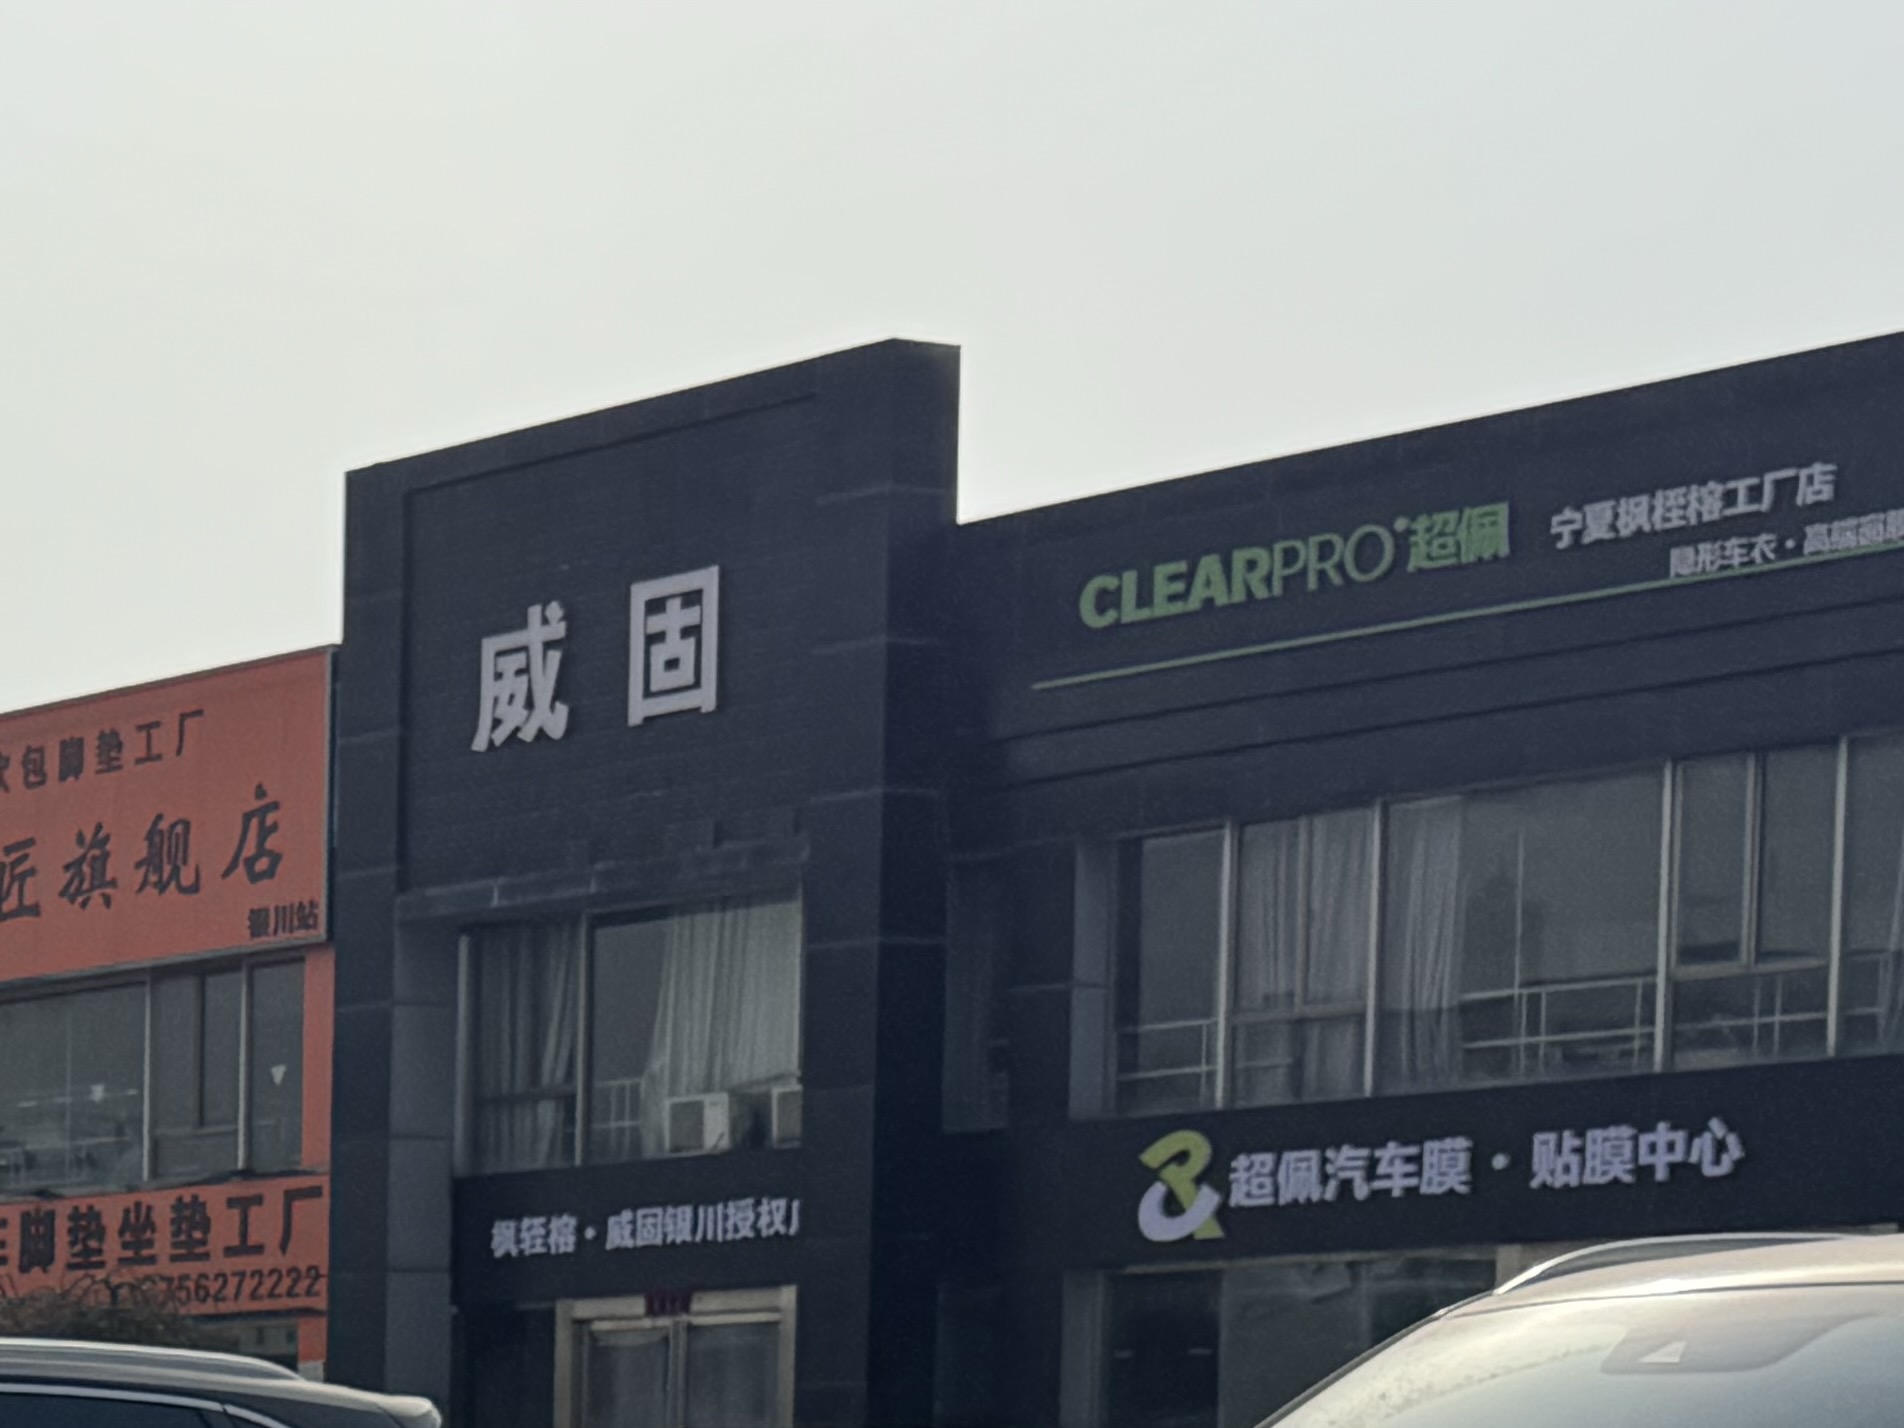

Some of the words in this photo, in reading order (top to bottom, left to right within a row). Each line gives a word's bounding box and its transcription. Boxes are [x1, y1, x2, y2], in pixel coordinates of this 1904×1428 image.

[1078, 523, 1396, 629] CLEARPRO
[1406, 502, 1510, 572] 超佩
[471, 564, 720, 752] 威固
[247, 899, 319, 939] 银川站
